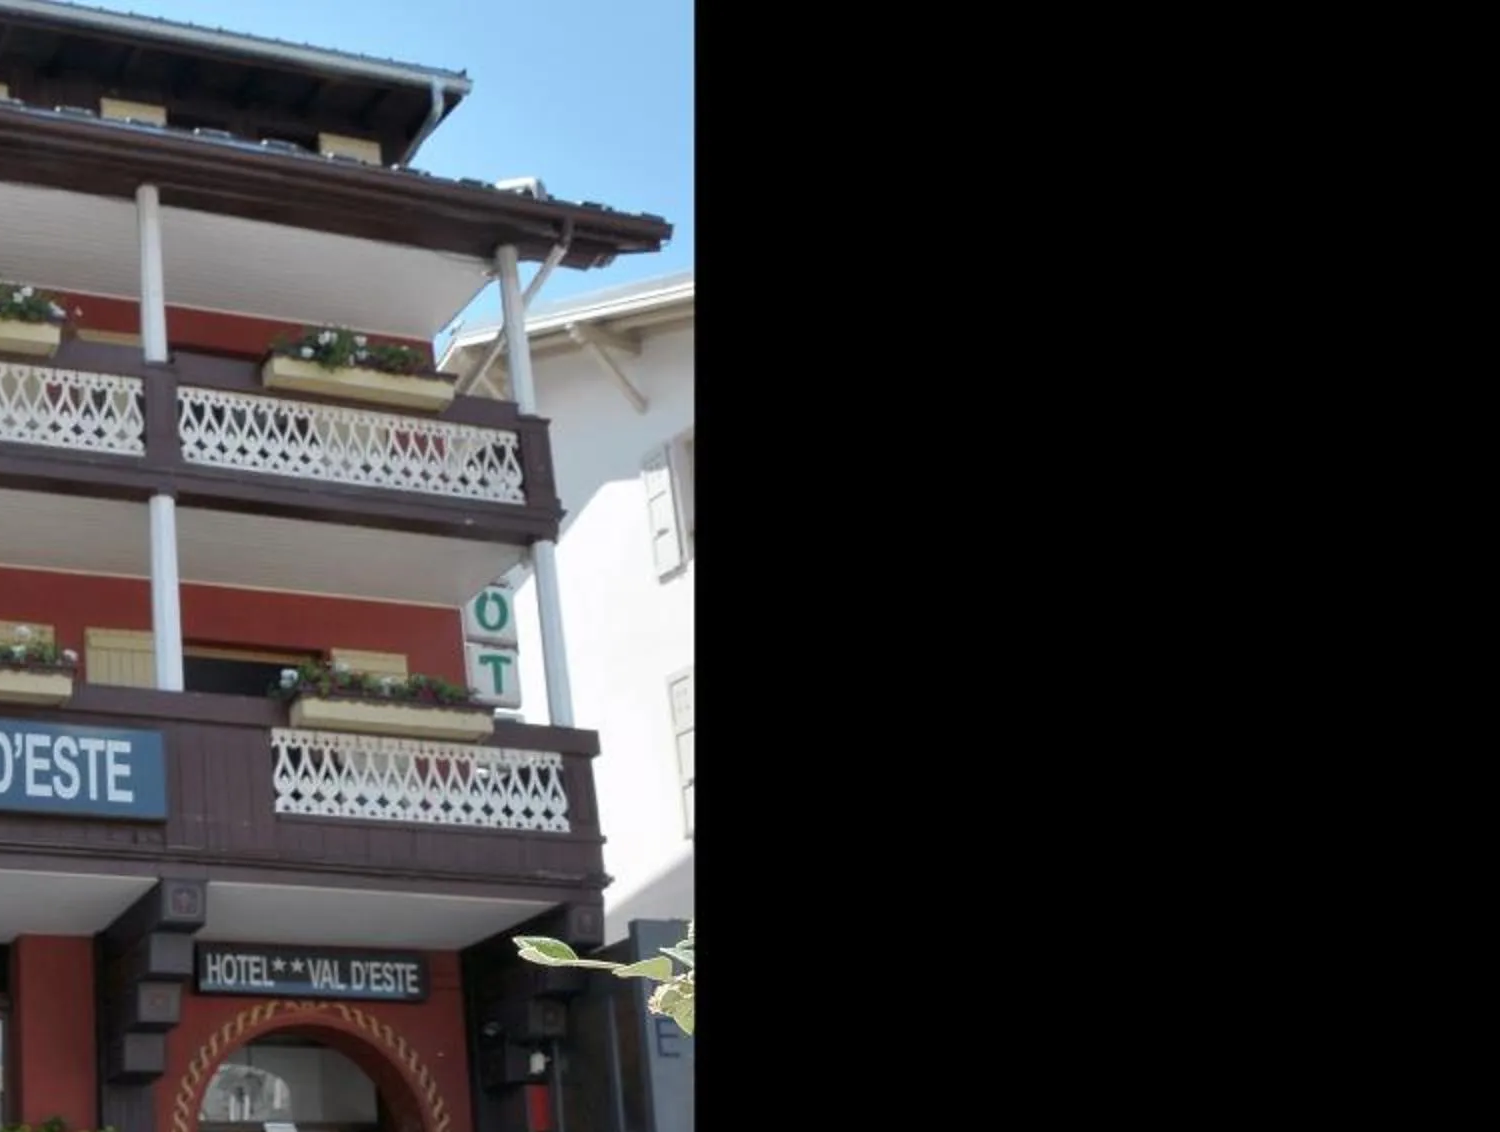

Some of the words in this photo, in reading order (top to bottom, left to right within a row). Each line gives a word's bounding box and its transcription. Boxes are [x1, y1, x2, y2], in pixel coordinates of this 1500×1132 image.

[206, 953, 275, 988] HOTEL
[307, 957, 347, 990] VAL
[351, 960, 420, 994] D'ESTE
